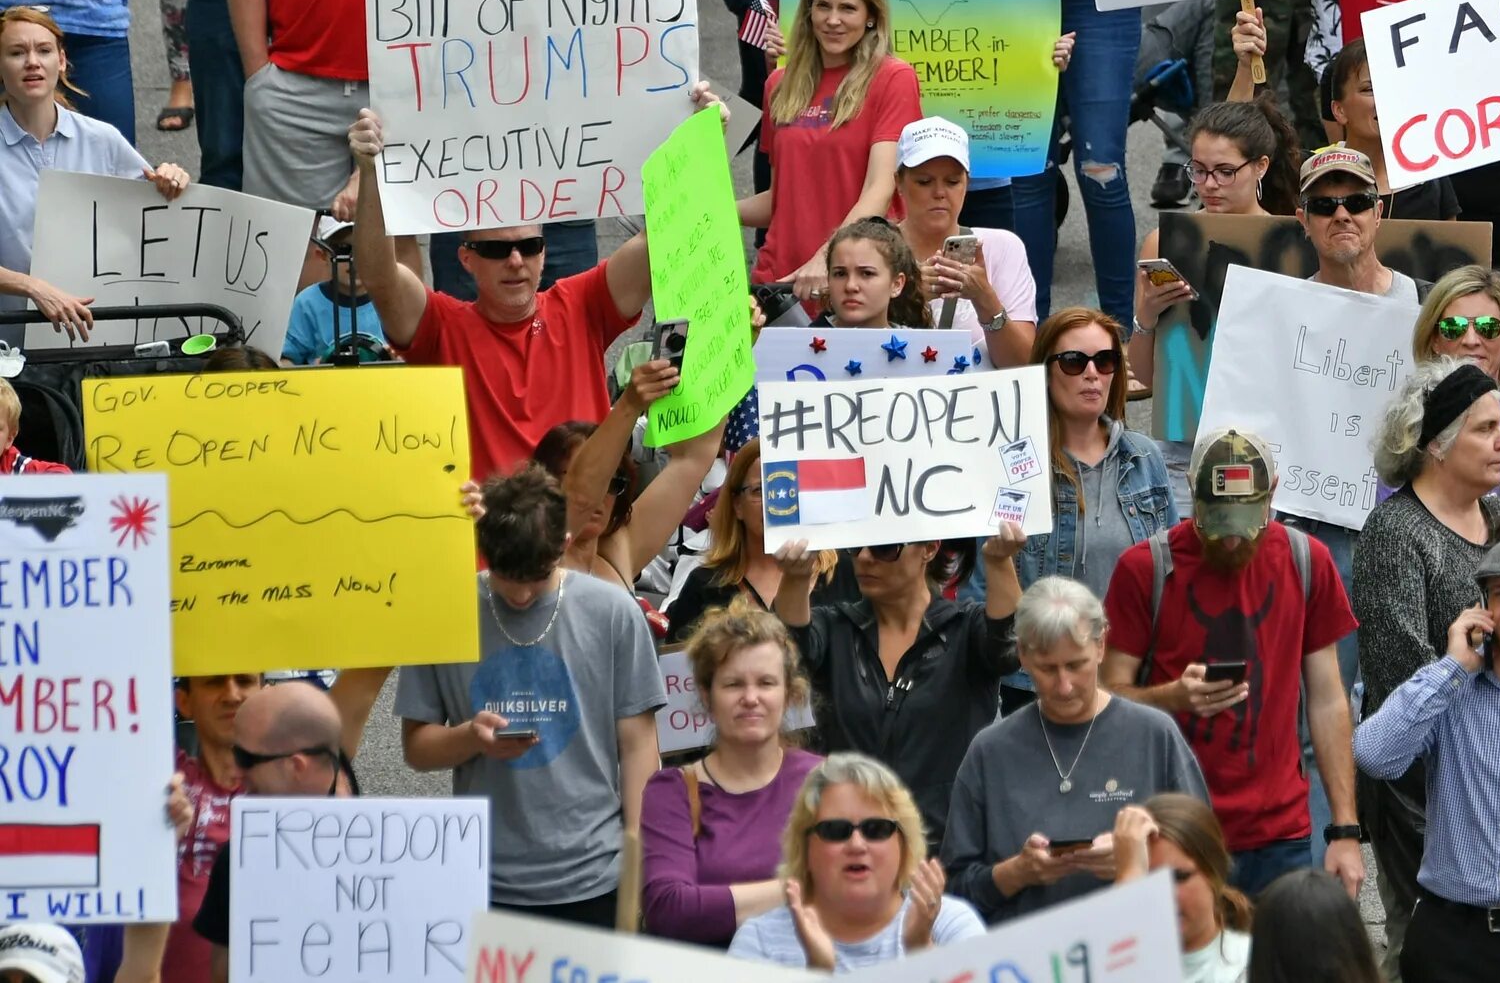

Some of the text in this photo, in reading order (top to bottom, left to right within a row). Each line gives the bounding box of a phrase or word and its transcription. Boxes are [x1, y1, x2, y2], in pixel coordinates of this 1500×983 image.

[386, 24, 694, 112] TRUMPS
[383, 121, 613, 184] EXECUTIVE
[433, 167, 626, 229] ORDER
[92, 200, 268, 291] LET US
[183, 376, 300, 402] COOPER
[762, 380, 1022, 453] #REOPEN
[294, 422, 340, 456] NC
[1011, 461, 1034, 474] OUT
[875, 458, 976, 516] NC
[994, 512, 1022, 521] WORK
[485, 699, 567, 713] QUIKSILVER
[48, 888, 147, 918] WILL!
[334, 876, 396, 914] NOT
[477, 946, 535, 983] MY
